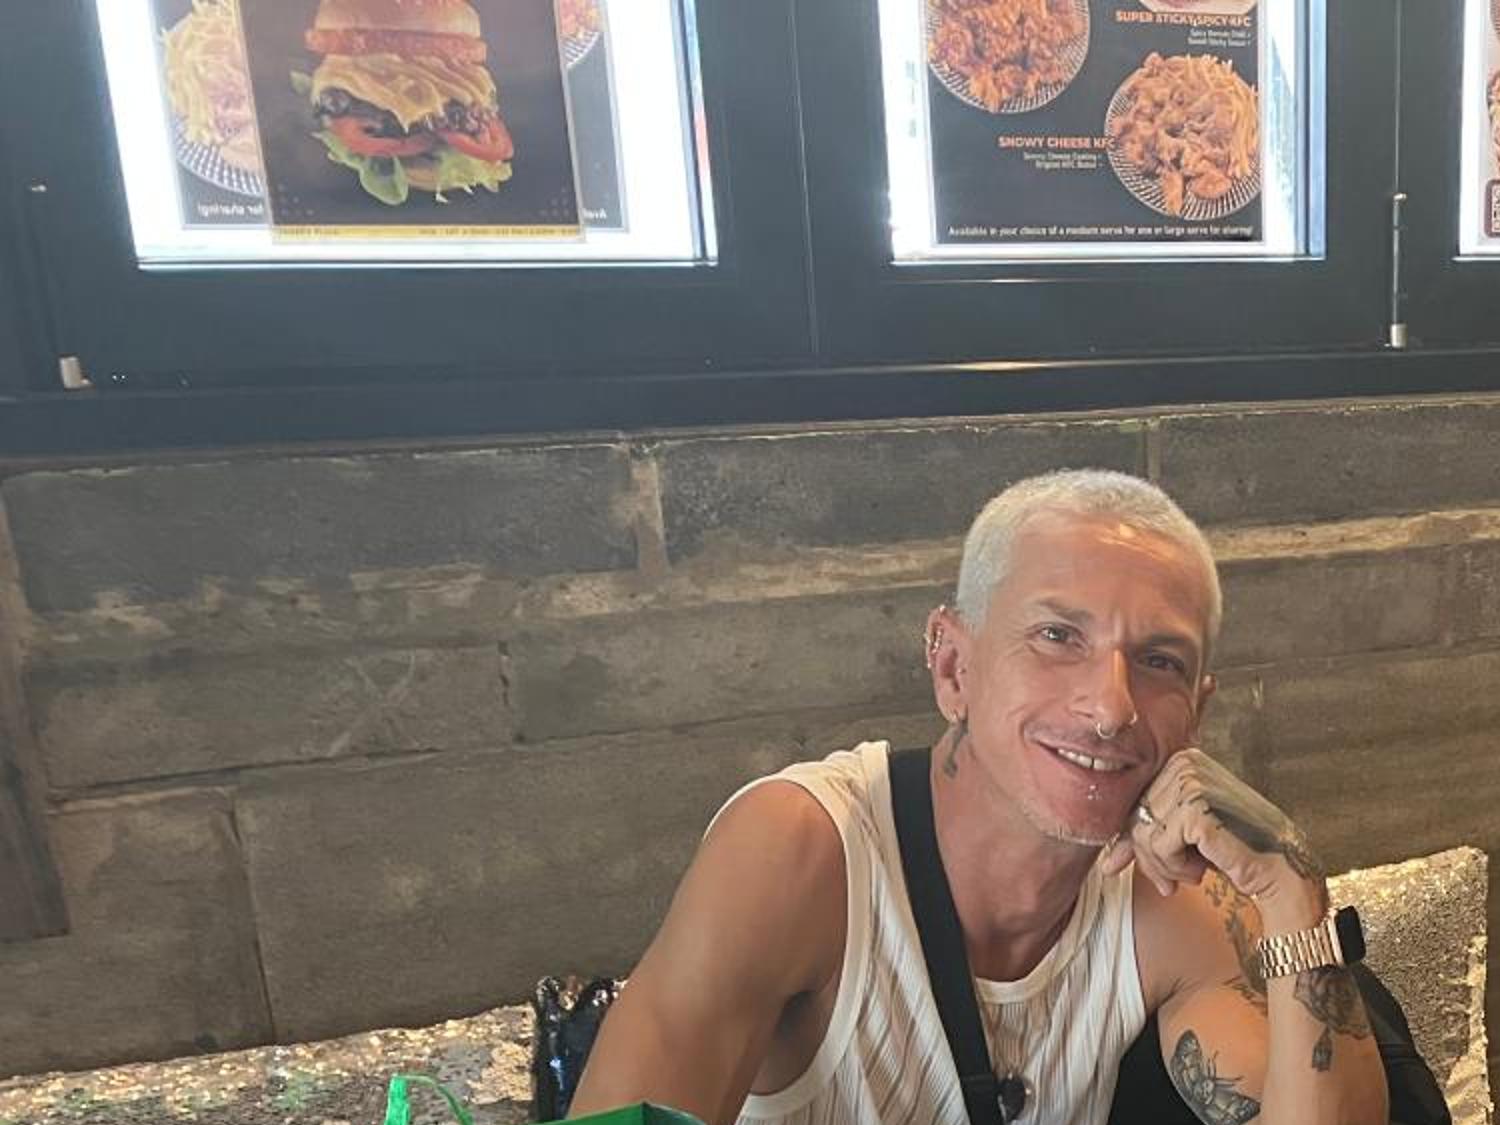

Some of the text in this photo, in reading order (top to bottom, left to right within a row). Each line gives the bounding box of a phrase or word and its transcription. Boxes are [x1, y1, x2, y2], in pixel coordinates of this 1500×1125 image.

[1115, 10, 1153, 23] SUPER
[997, 136, 1116, 149] SNOWY CHEESE KFC
